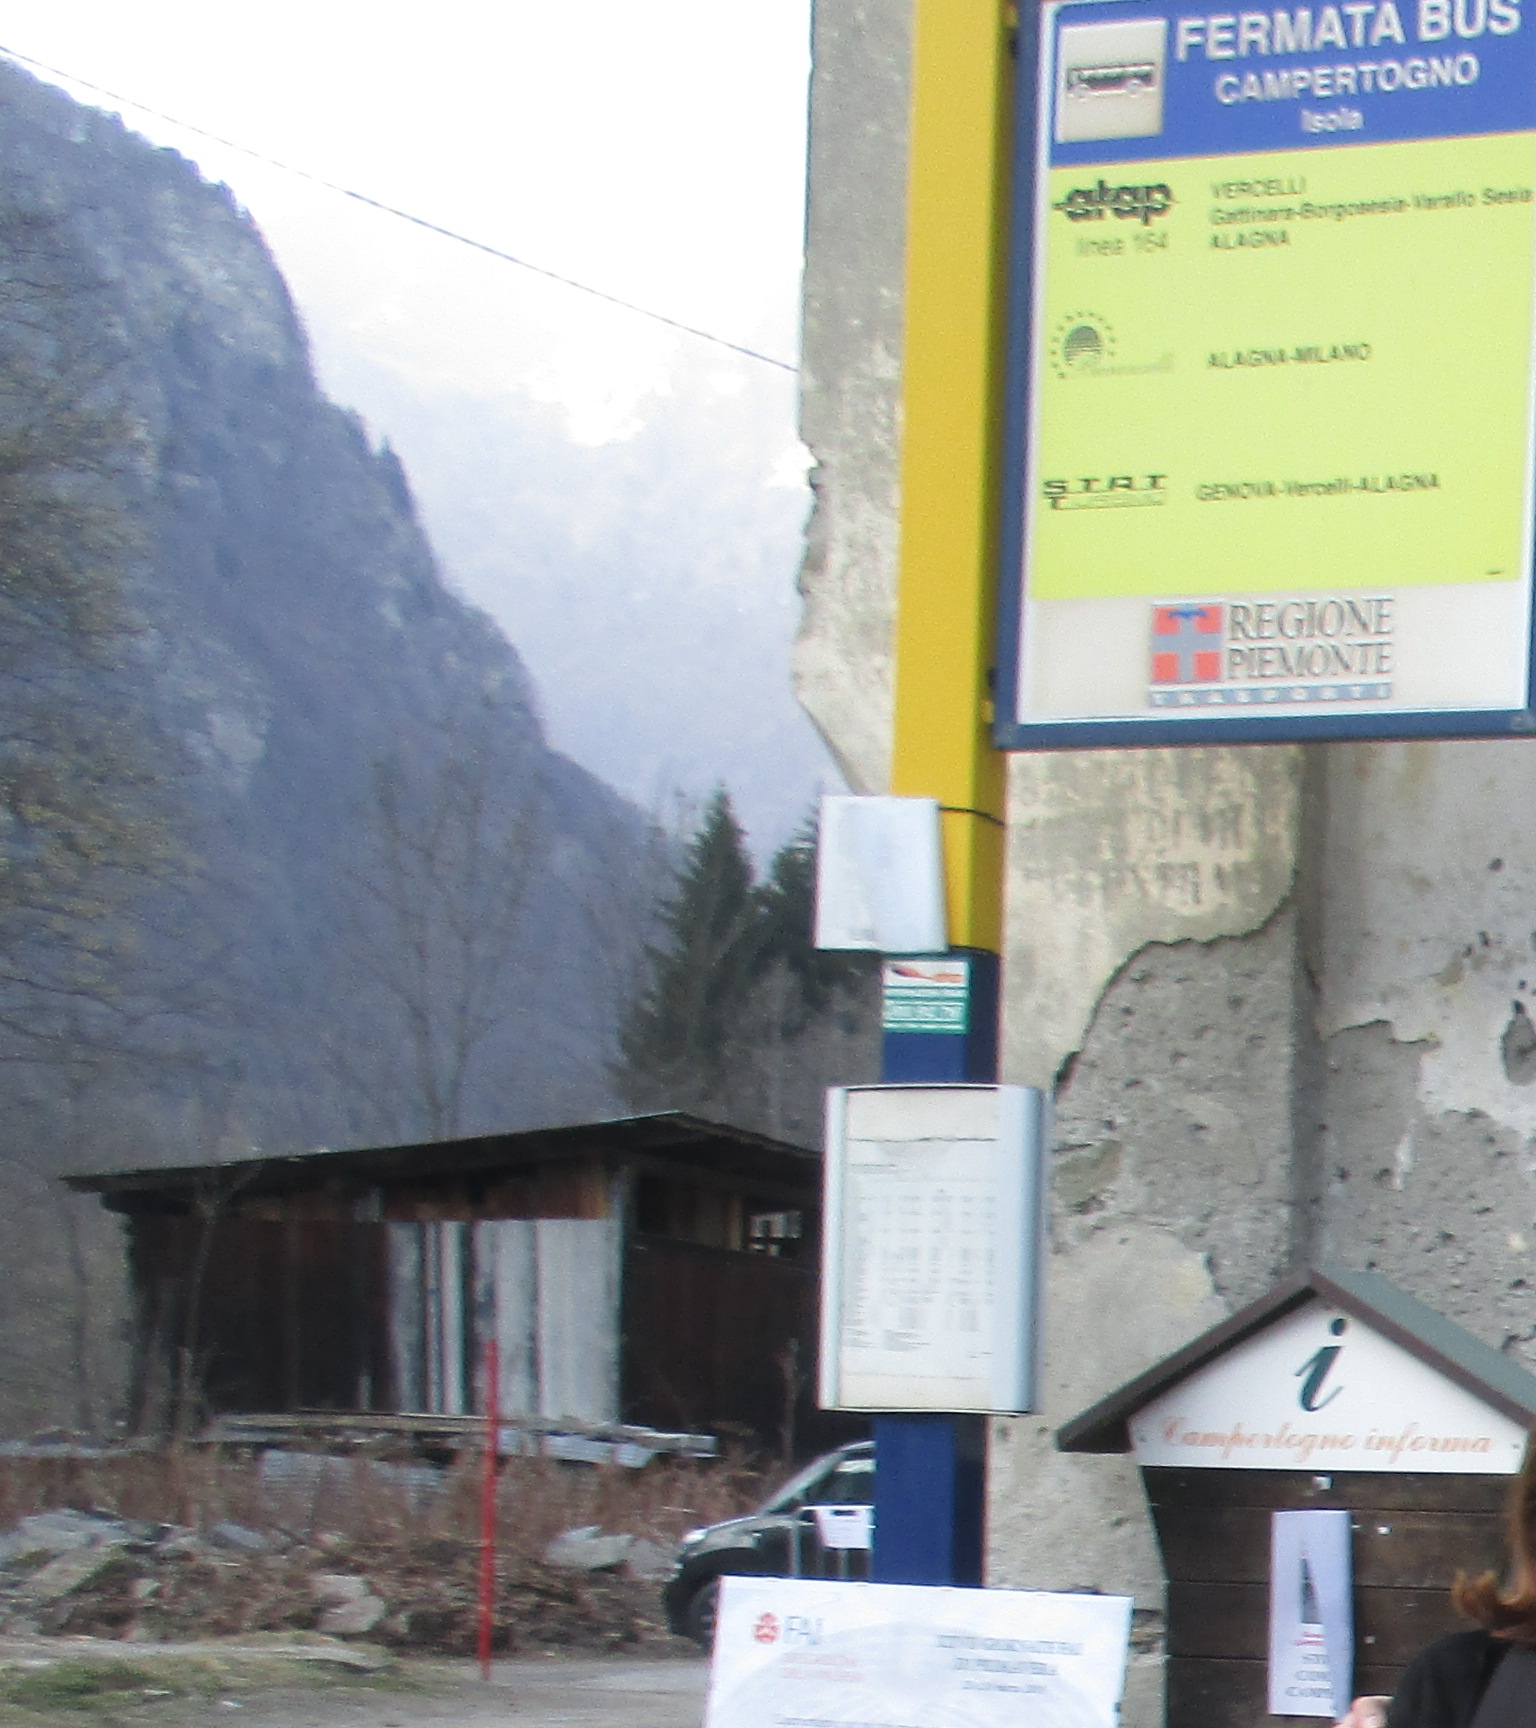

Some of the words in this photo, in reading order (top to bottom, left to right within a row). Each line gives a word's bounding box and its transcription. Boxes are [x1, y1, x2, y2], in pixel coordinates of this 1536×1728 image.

[1175, 1, 1406, 62] FERMATA
[1417, 0, 1522, 42] BUS
[1214, 53, 1481, 105] CAMPERTOGNO
[1301, 107, 1364, 133] Isola
[1060, 179, 1175, 226] atap
[1210, 176, 1306, 199] VERCELLI
[1481, 187, 1533, 205] Sesia
[1210, 229, 1292, 248] ALAGNA
[1208, 342, 1371, 369] ALAGNA-MILANO
[1229, 598, 1393, 640] REGIONE
[1227, 642, 1393, 679] PIEMONTE
[1160, 1417, 1353, 1462] Campertogno
[1364, 1428, 1491, 1463] informa
